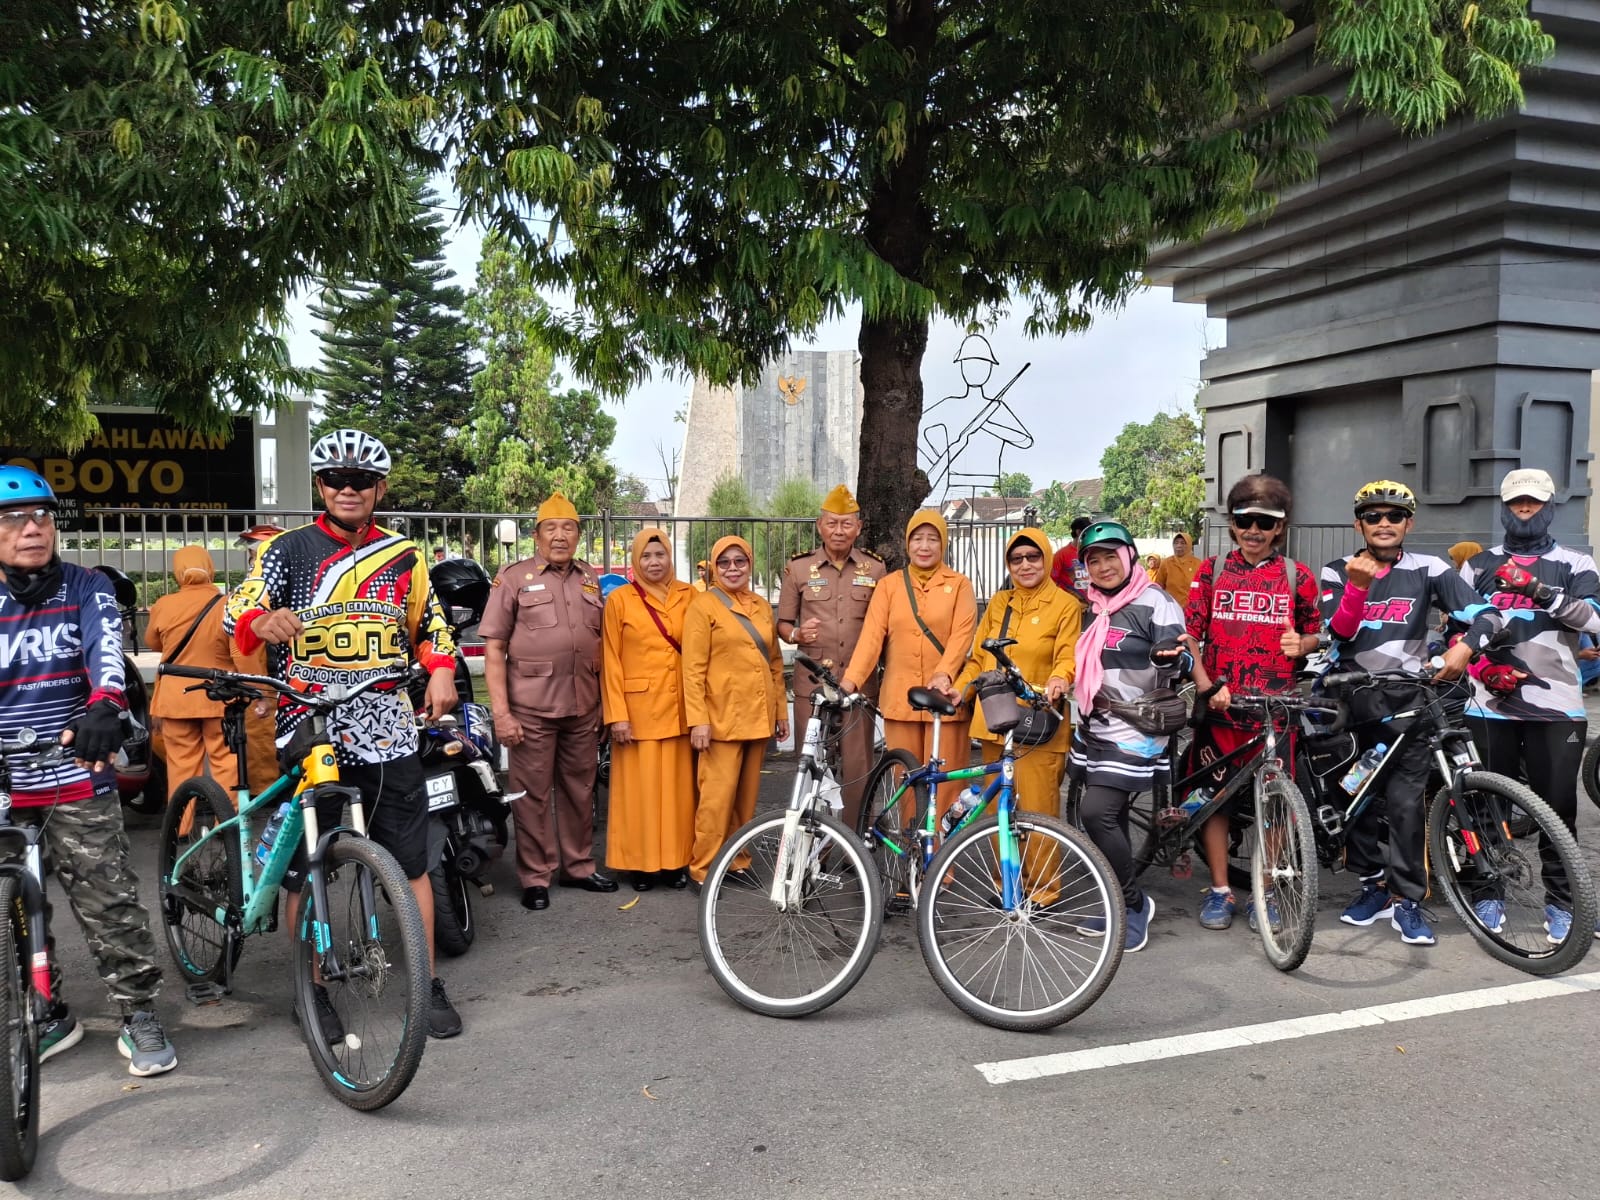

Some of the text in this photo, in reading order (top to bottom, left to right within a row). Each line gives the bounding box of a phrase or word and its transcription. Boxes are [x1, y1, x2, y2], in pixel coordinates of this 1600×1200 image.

[91, 427, 226, 450] AHLAWAN
[1212, 589, 1290, 616] PEDE
[1212, 611, 1285, 625] PARE FEDERALIS
[288, 663, 350, 685] POKOKE
